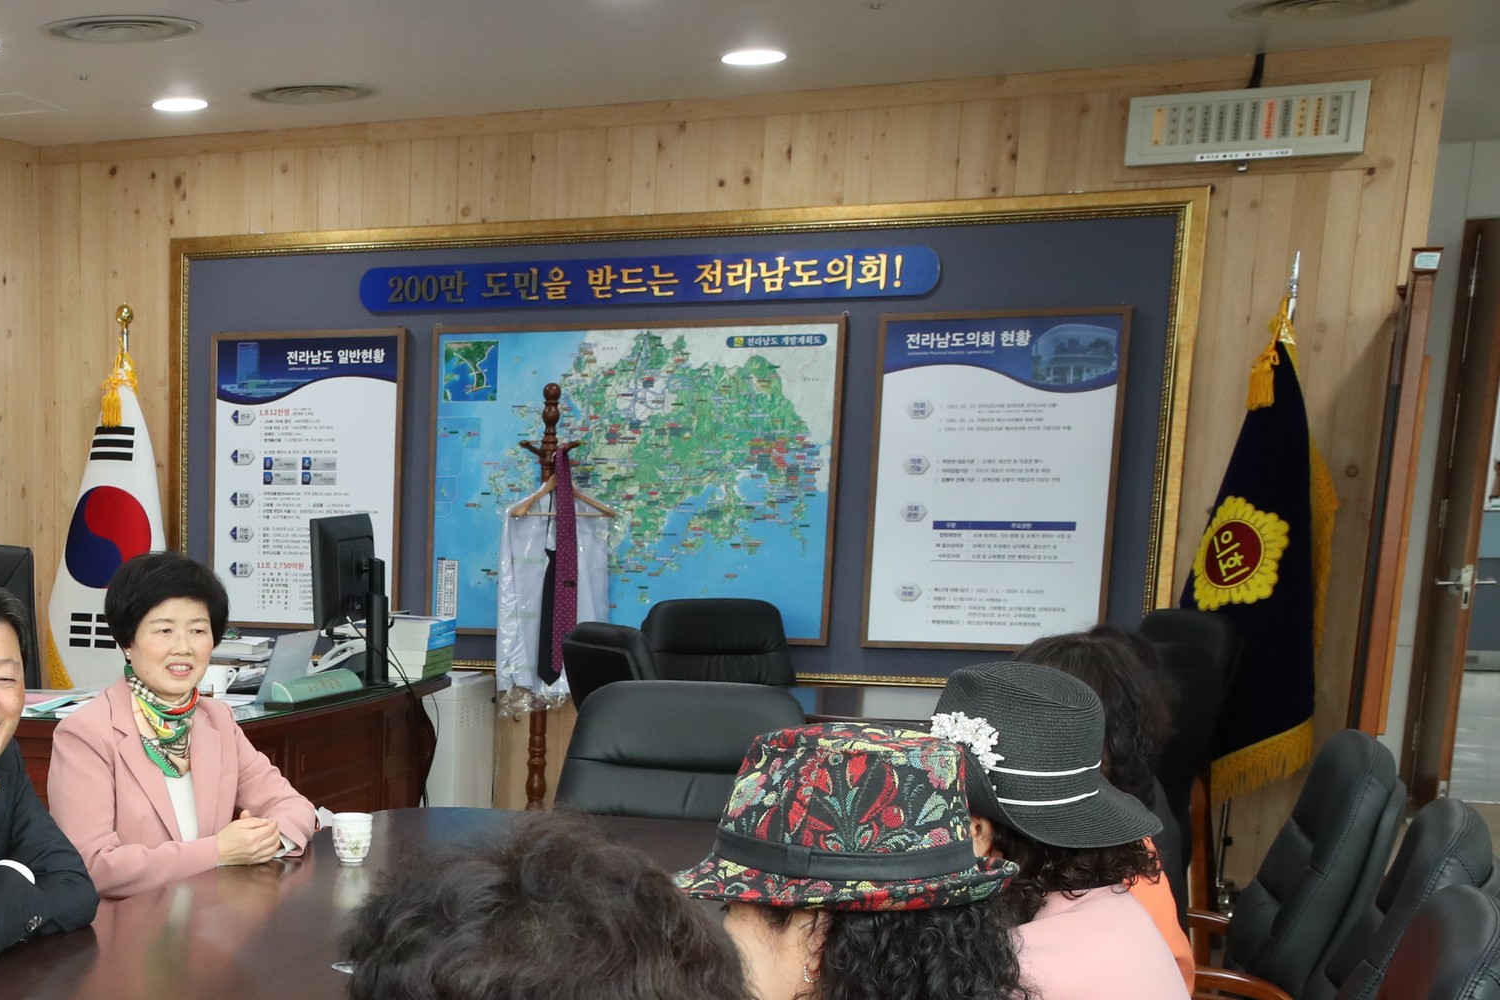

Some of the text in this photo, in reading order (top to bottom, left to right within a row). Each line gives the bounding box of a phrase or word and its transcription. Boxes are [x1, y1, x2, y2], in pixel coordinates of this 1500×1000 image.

[387, 253, 904, 304] 200만 도민을 받드는 전라남도의회!
[746, 335, 822, 347] 전라남도 개발계획도
[906, 329, 1032, 349] 전라남도의회 현황
[286, 348, 386, 365] 전라남도 일반현황
[259, 408, 290, 416] 1,832천명
[273, 562, 304, 570] 2,750억원
